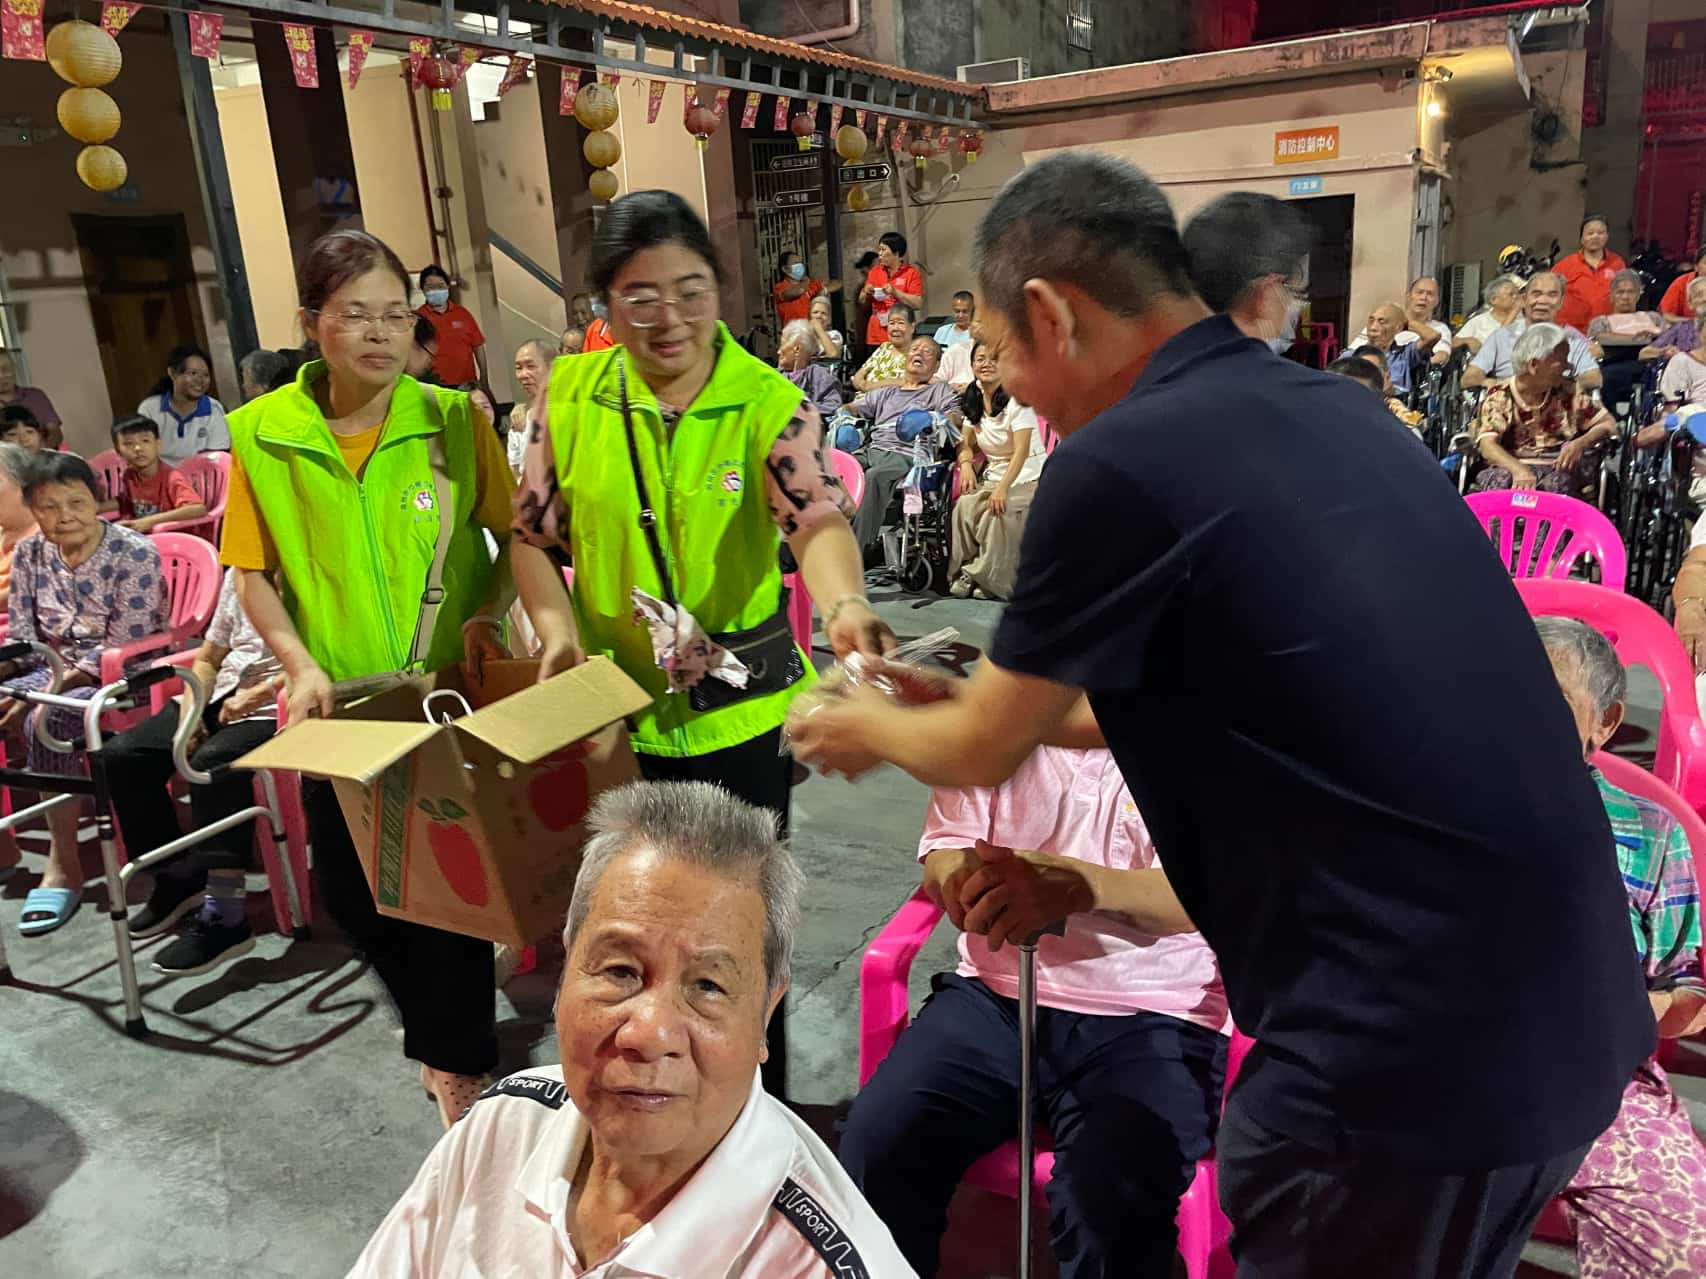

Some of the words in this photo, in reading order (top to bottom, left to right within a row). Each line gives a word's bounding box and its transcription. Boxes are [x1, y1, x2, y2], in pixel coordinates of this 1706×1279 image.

[1278, 135, 1335, 156] 消防控制中心
[509, 1079, 546, 1090] SPORT
[796, 1204, 829, 1237] SPORT
